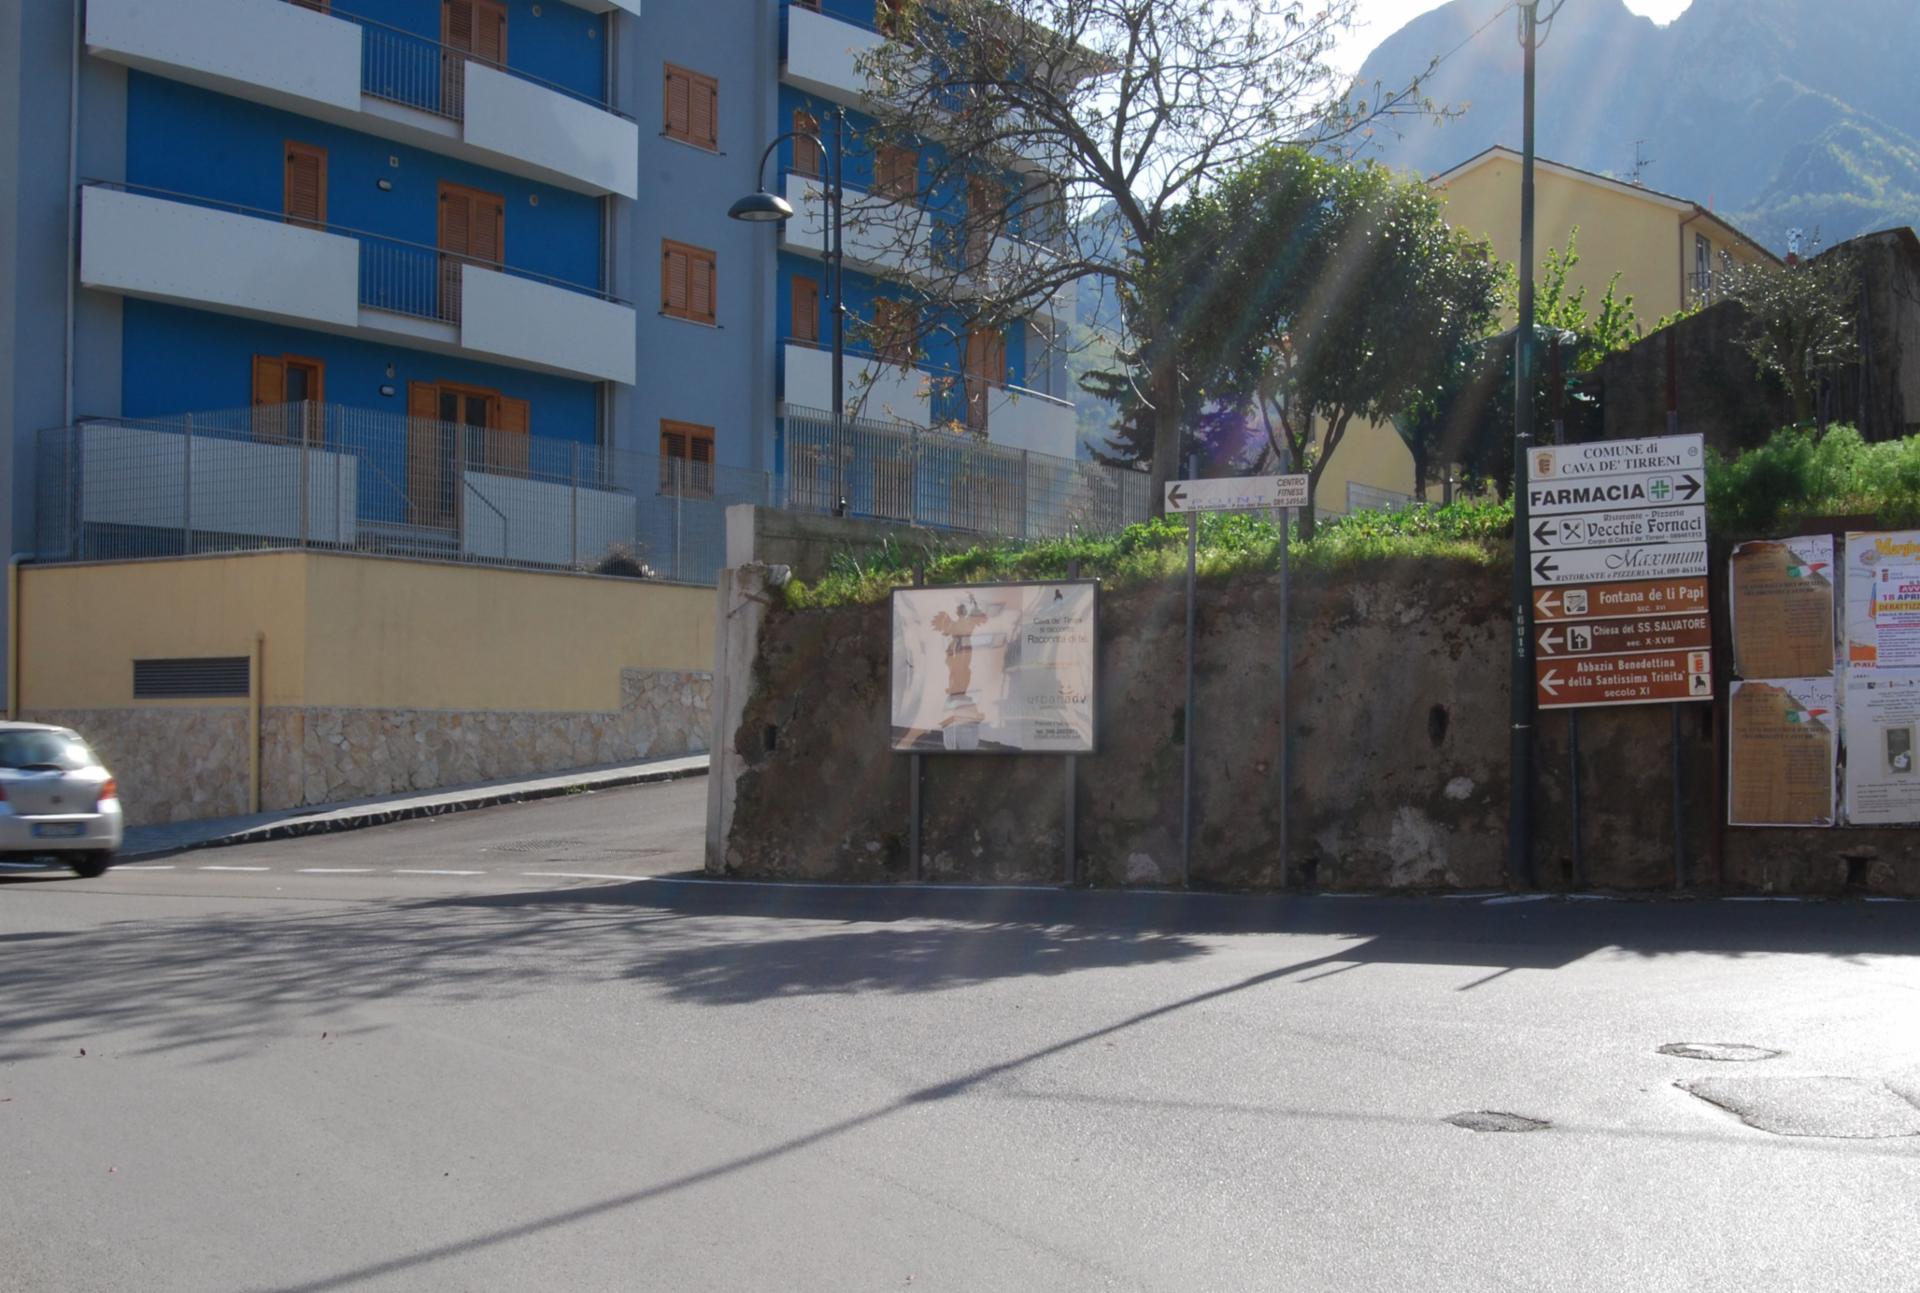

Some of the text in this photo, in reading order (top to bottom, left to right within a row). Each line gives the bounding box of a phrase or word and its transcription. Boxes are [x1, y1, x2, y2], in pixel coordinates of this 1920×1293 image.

[1583, 443, 1658, 460] COMUNE di
[1562, 455, 1681, 475] CAVA DE' TIRRENI
[1277, 479, 1305, 488] CENTRO
[1530, 483, 1645, 507] FARMACIA
[1587, 516, 1702, 538] Vecchie Fornaci
[1605, 549, 1704, 570] Maximum
[1555, 571, 1606, 582] RISTORANTE
[1613, 568, 1650, 579] PIZZERIA
[1600, 585, 1704, 605] Fontana de li Papi
[1593, 624, 1620, 636] Chiesa
[1623, 623, 1635, 633] del
[1654, 618, 1706, 632] SALVATORE
[1577, 657, 1675, 673] Abbazia Benedettina
[1568, 676, 1592, 688] della
[1596, 673, 1648, 686] Santissima
[1604, 686, 1650, 697] secolo XI
